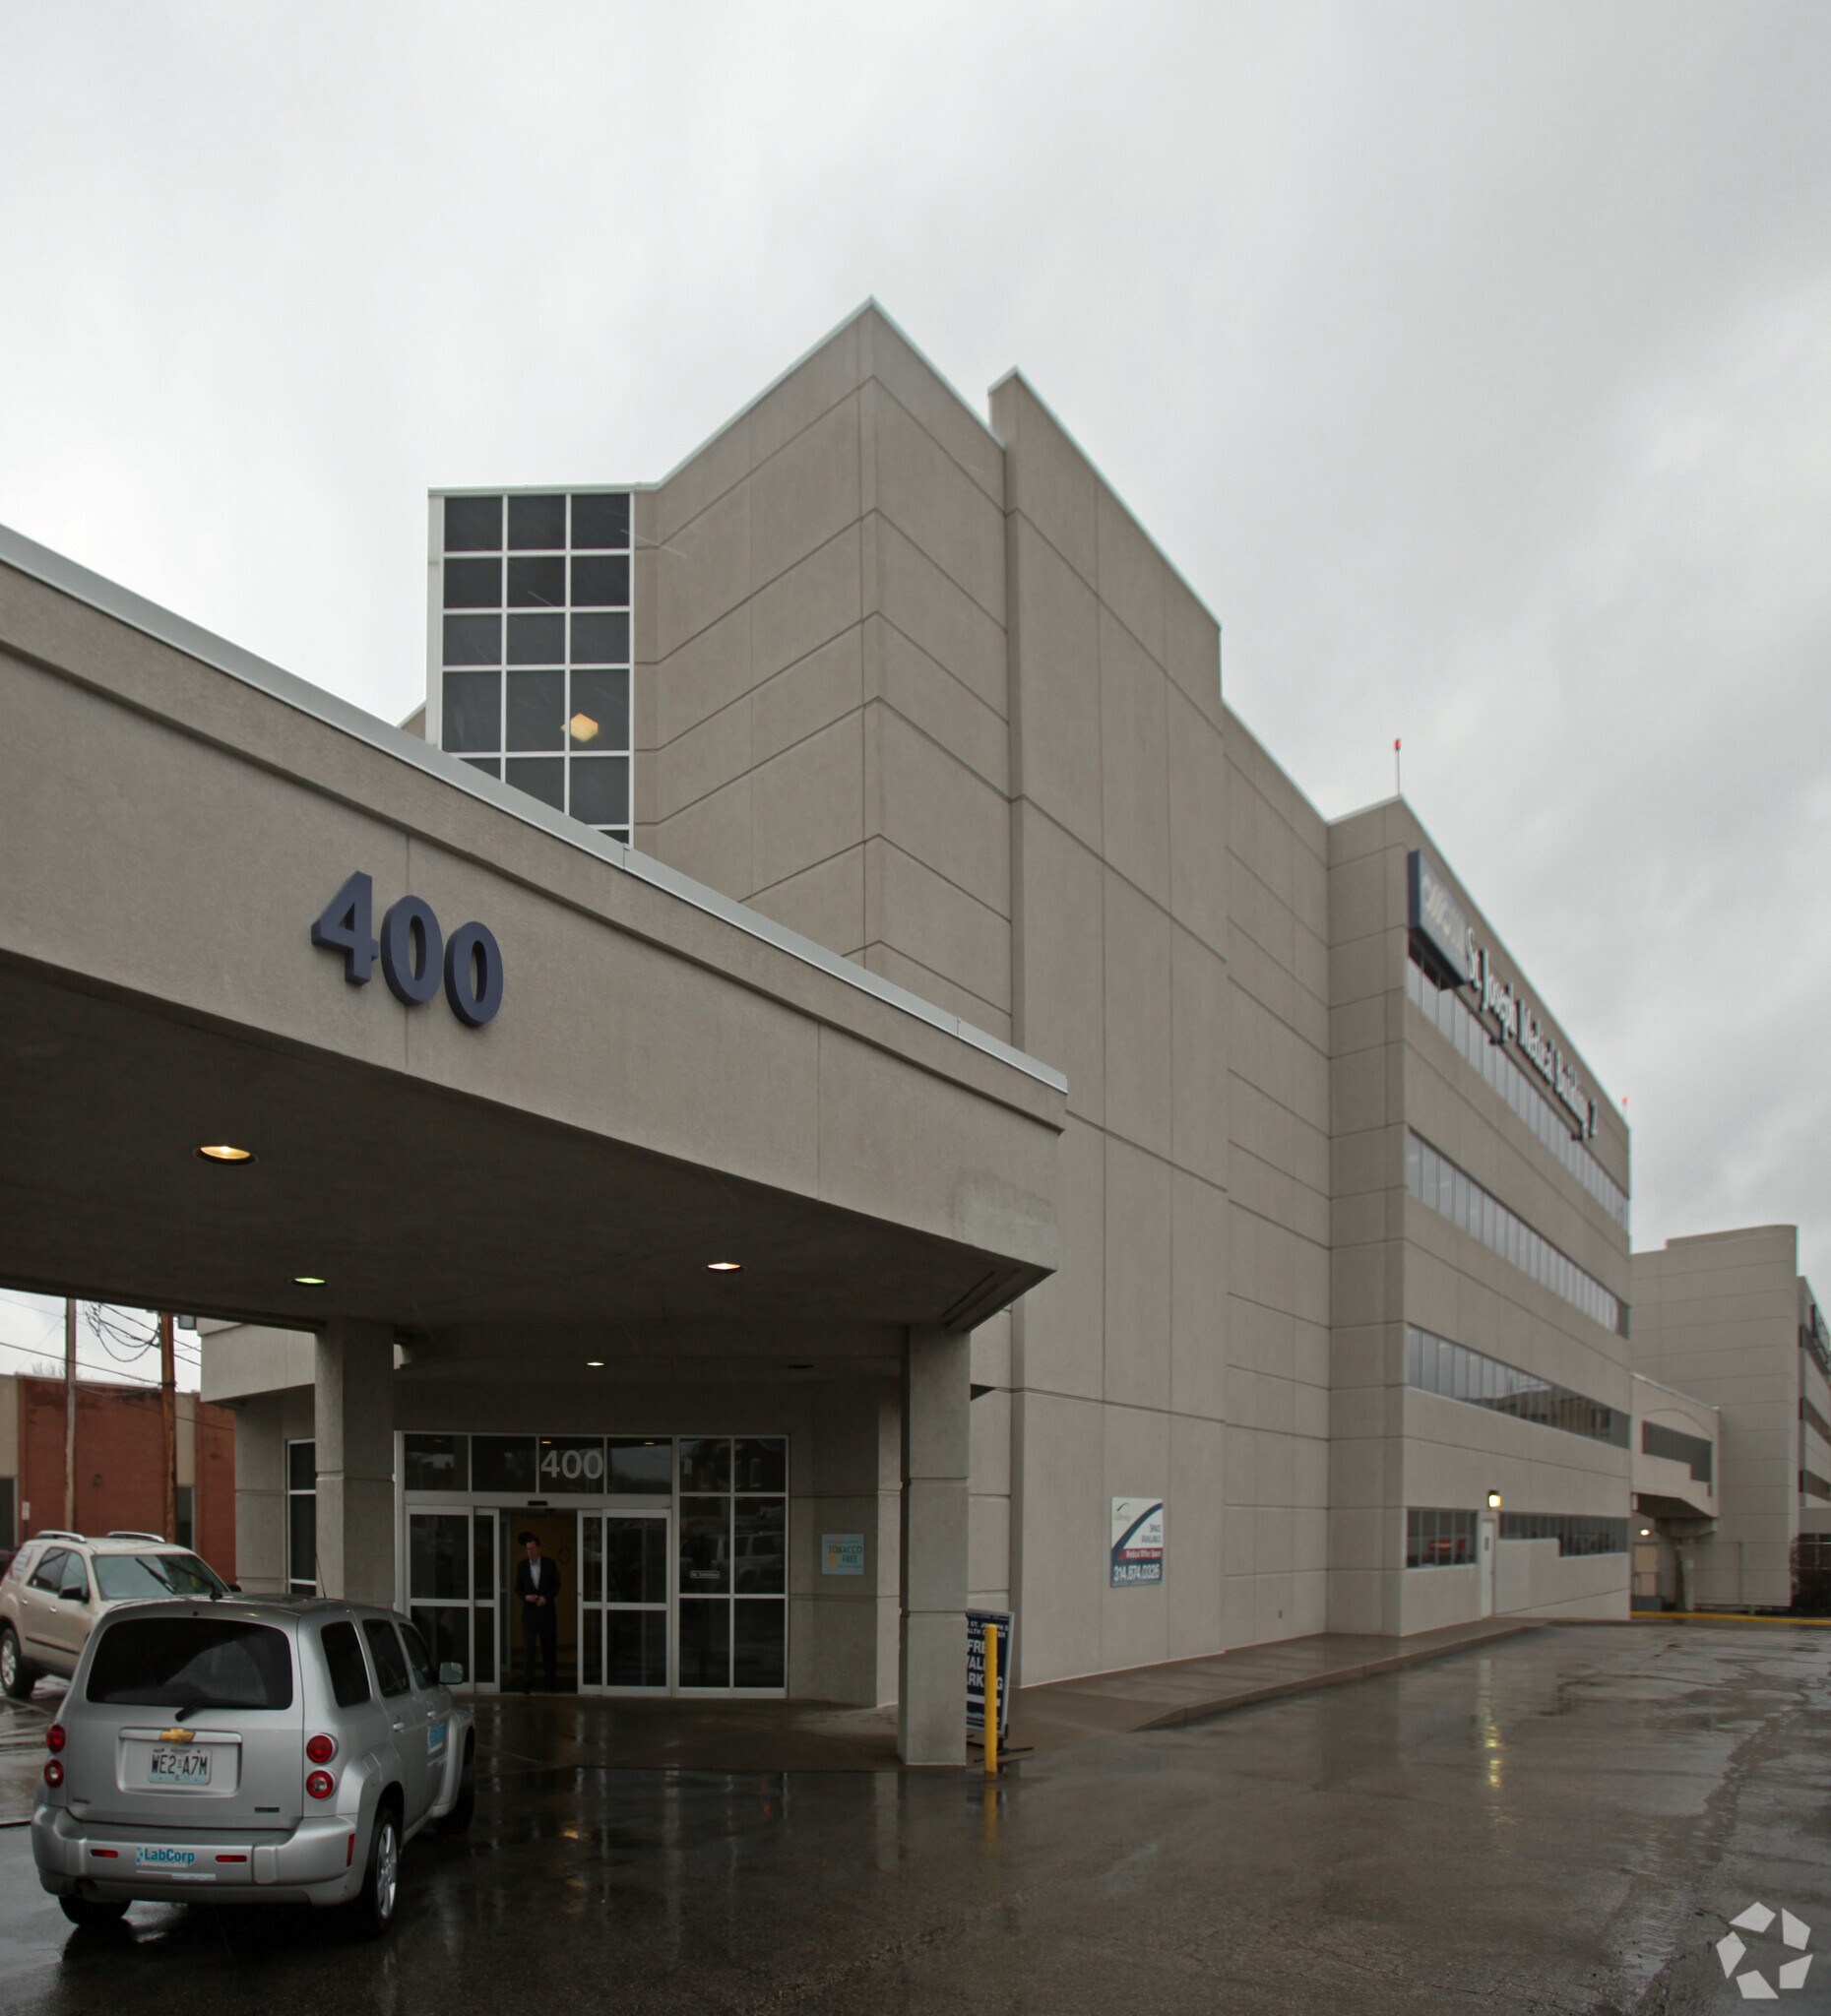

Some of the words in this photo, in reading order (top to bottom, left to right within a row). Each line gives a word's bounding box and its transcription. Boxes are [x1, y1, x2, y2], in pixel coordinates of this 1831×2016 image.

[311, 870, 503, 1027] 400
[1480, 948, 1515, 1041] Joseph
[540, 1450, 603, 1480] 400
[828, 1545, 862, 1554] TOBACCO
[842, 1554, 859, 1563] FREE
[144, 1848, 195, 1864] LabCorp
